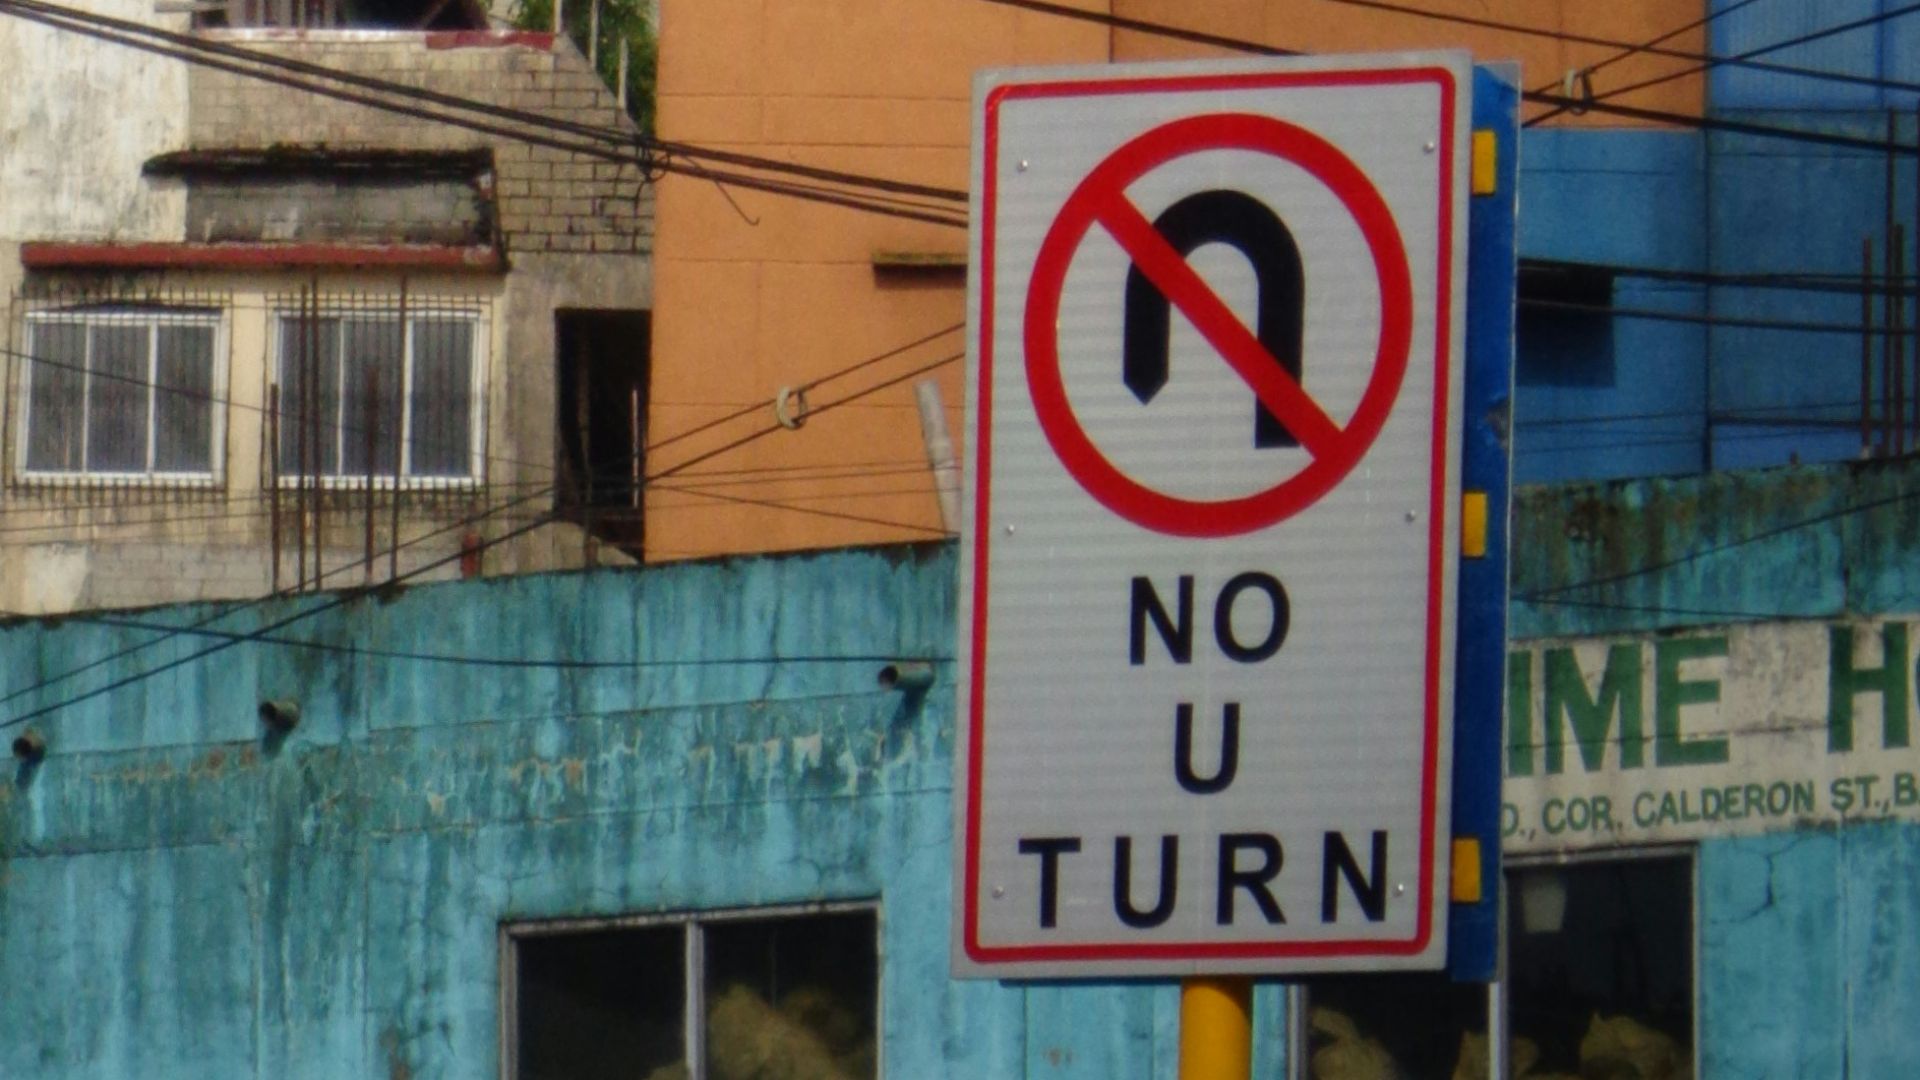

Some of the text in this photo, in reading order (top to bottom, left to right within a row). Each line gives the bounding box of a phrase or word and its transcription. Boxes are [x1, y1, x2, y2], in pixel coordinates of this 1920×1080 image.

[1130, 571, 1291, 665] NO
[1827, 621, 1920, 754] H
[1174, 702, 1241, 795] U
[1633, 780, 1814, 828] CALDERON
[1018, 829, 1388, 930] TURN
